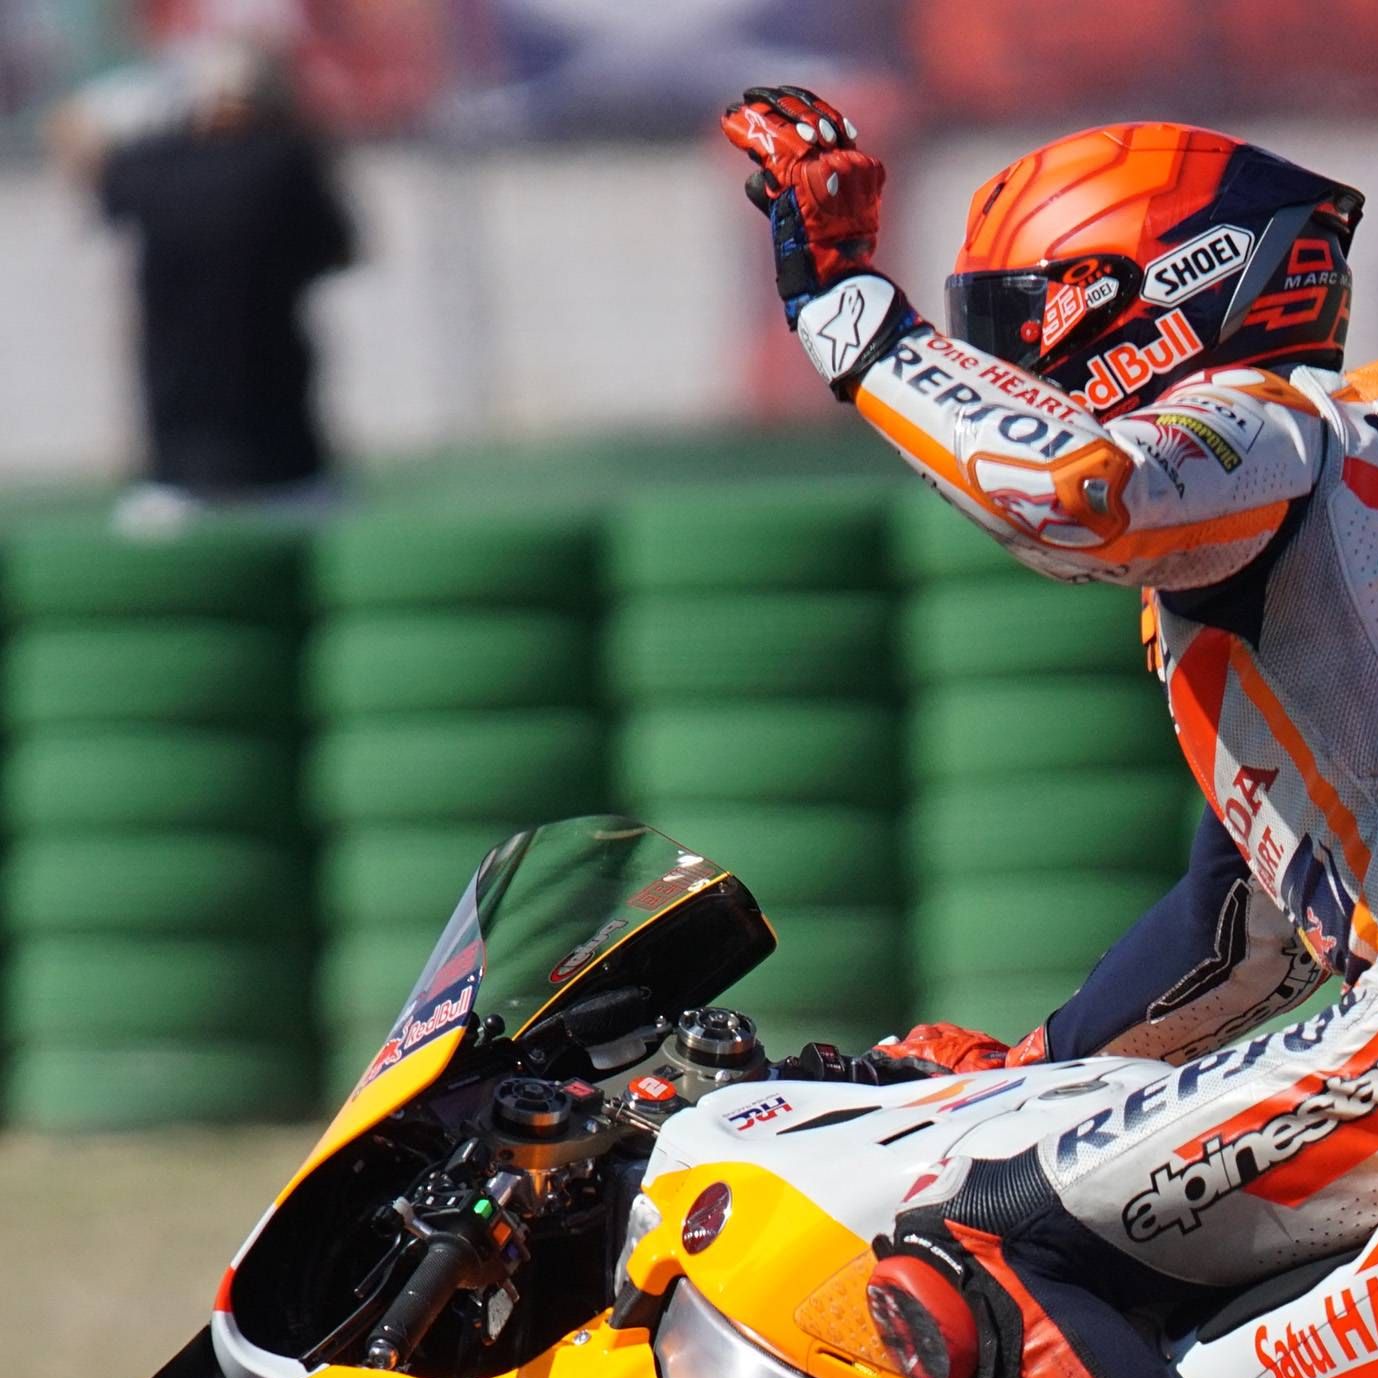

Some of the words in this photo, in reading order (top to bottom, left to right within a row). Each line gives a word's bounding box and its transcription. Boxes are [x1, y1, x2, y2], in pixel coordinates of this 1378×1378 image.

[1155, 234, 1241, 296] SHOEI
[1284, 272, 1337, 289] MARC
[927, 336, 979, 371] One
[979, 364, 1080, 425] HEART.
